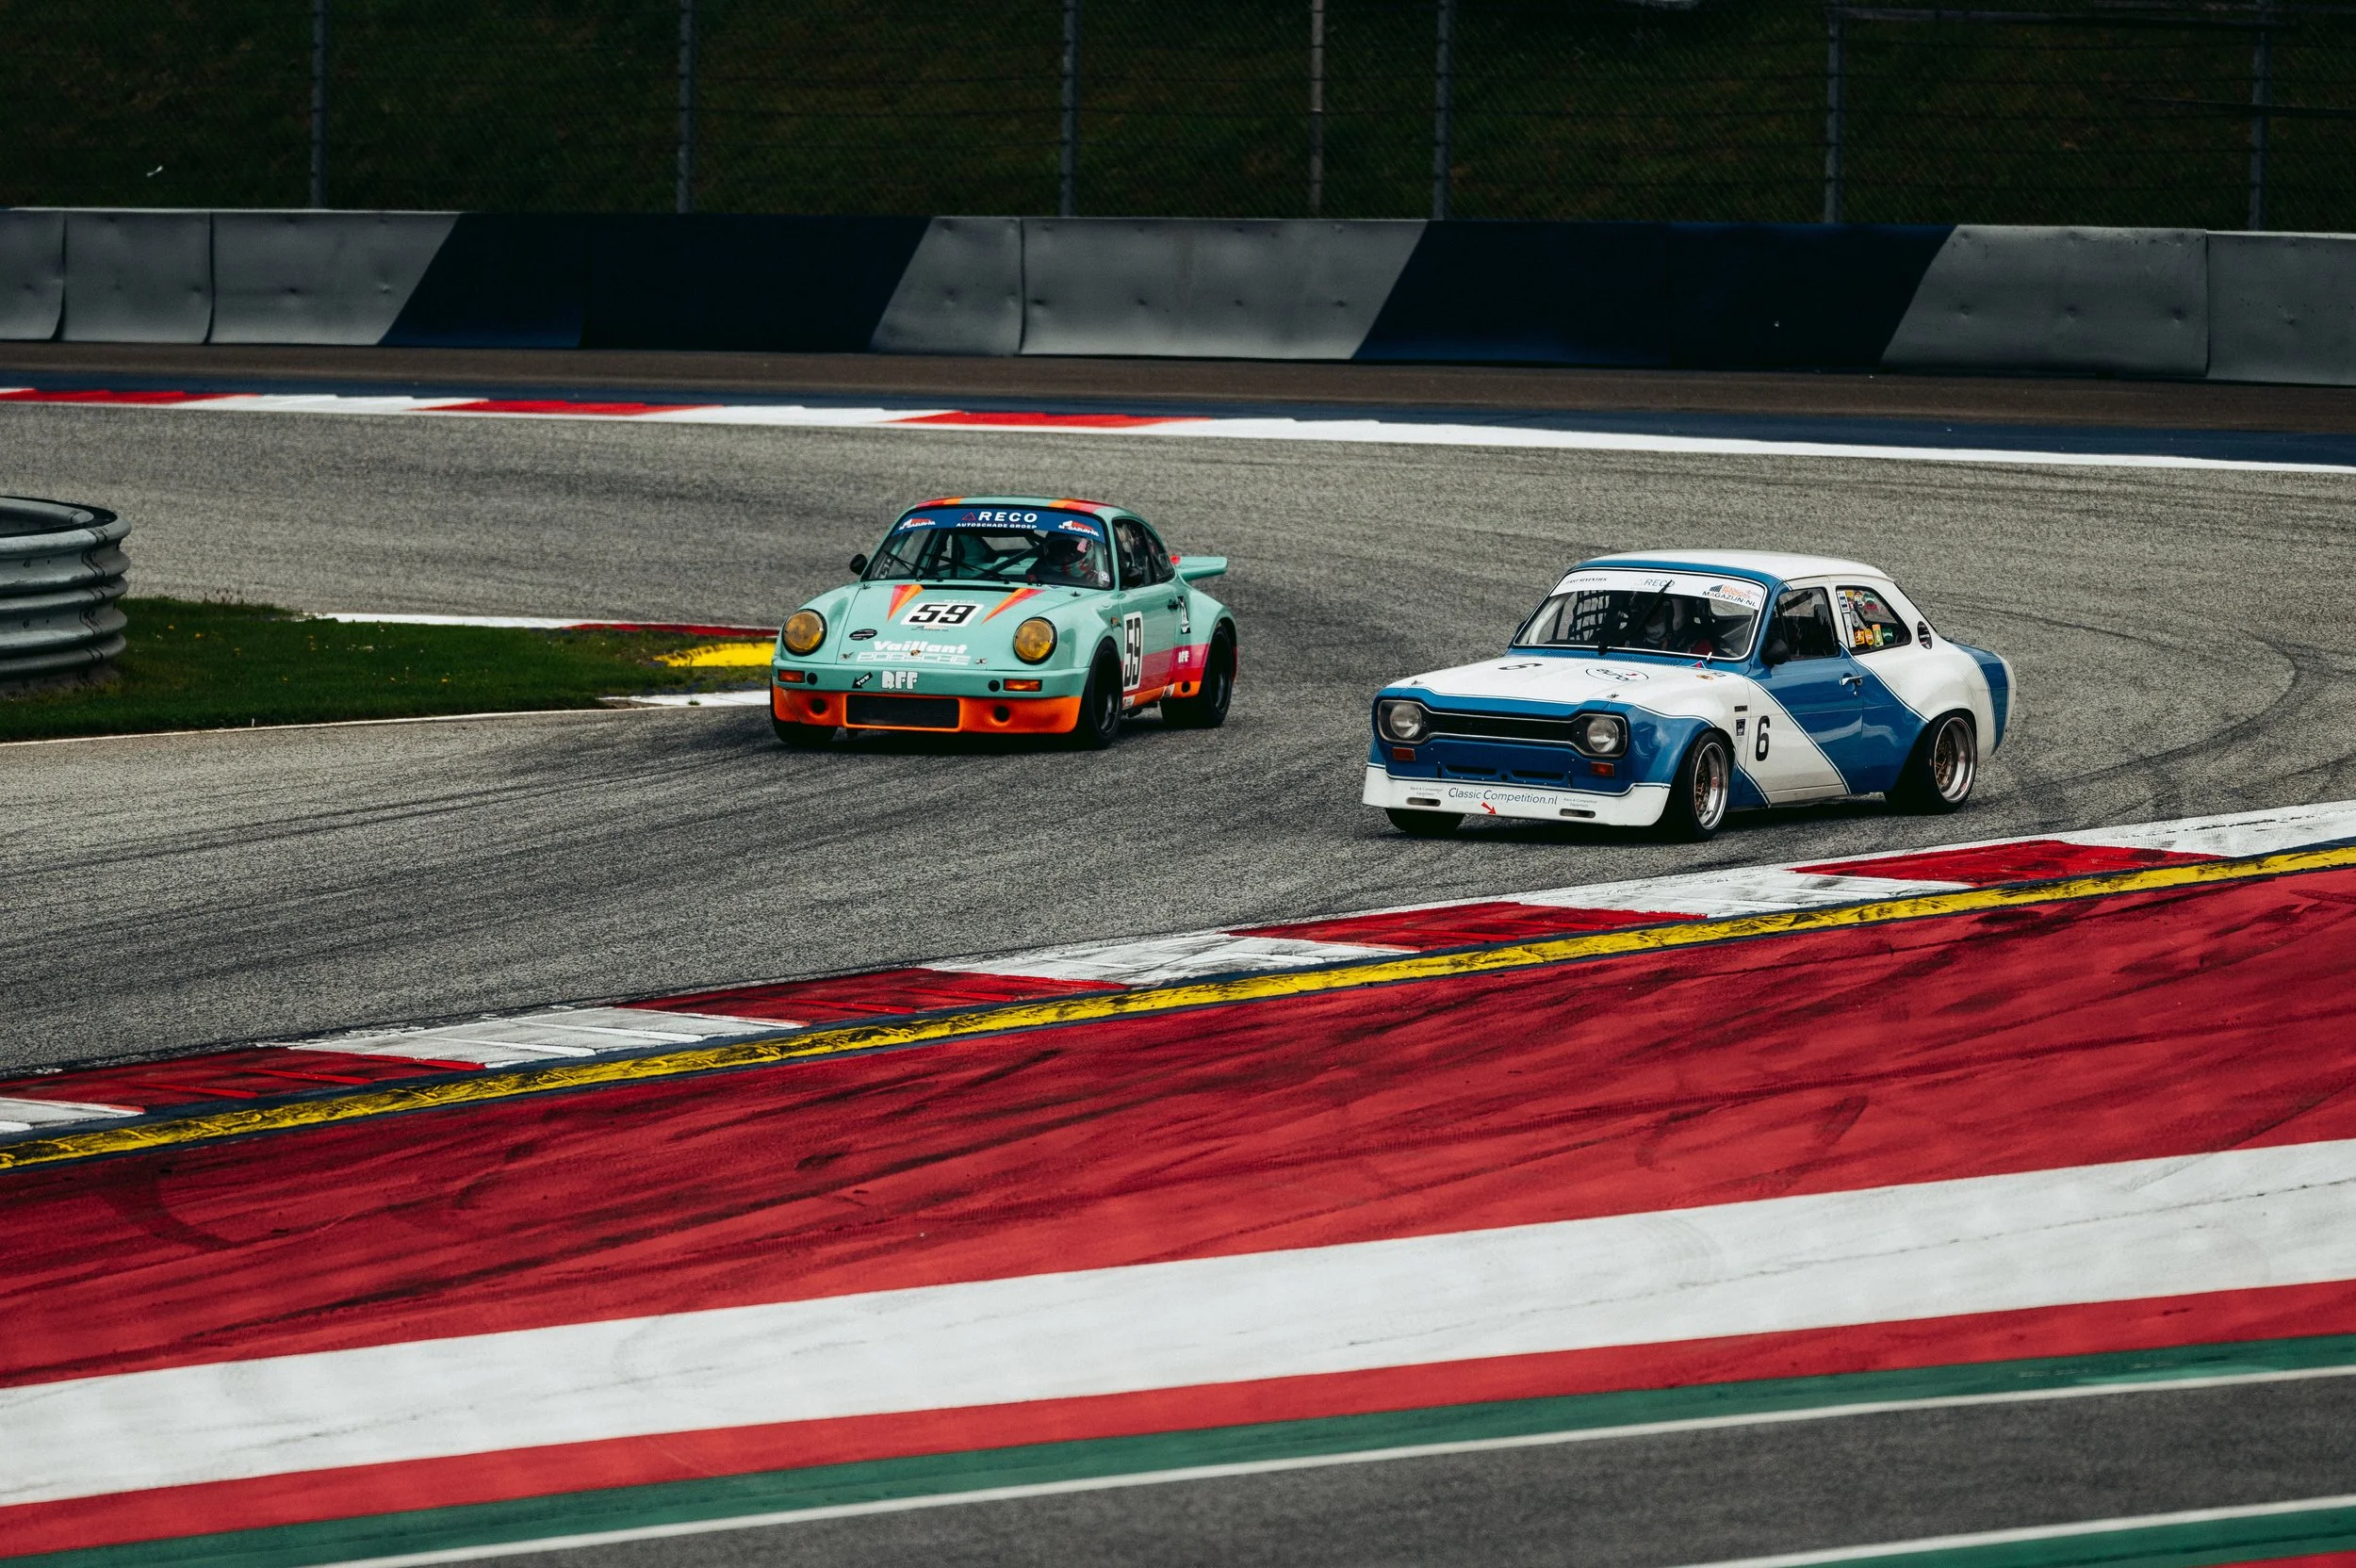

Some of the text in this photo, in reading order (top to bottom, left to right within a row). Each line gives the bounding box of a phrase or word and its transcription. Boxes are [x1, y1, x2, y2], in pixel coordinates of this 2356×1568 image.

[978, 512, 1038, 523] RECO
[908, 604, 977, 624] 59
[874, 641, 968, 654] Vaillant
[1124, 617, 1140, 687] 59
[857, 652, 971, 665] PORSCHE
[1755, 715, 1771, 761] 6
[1448, 788, 1558, 805] Classic Competition.nl
